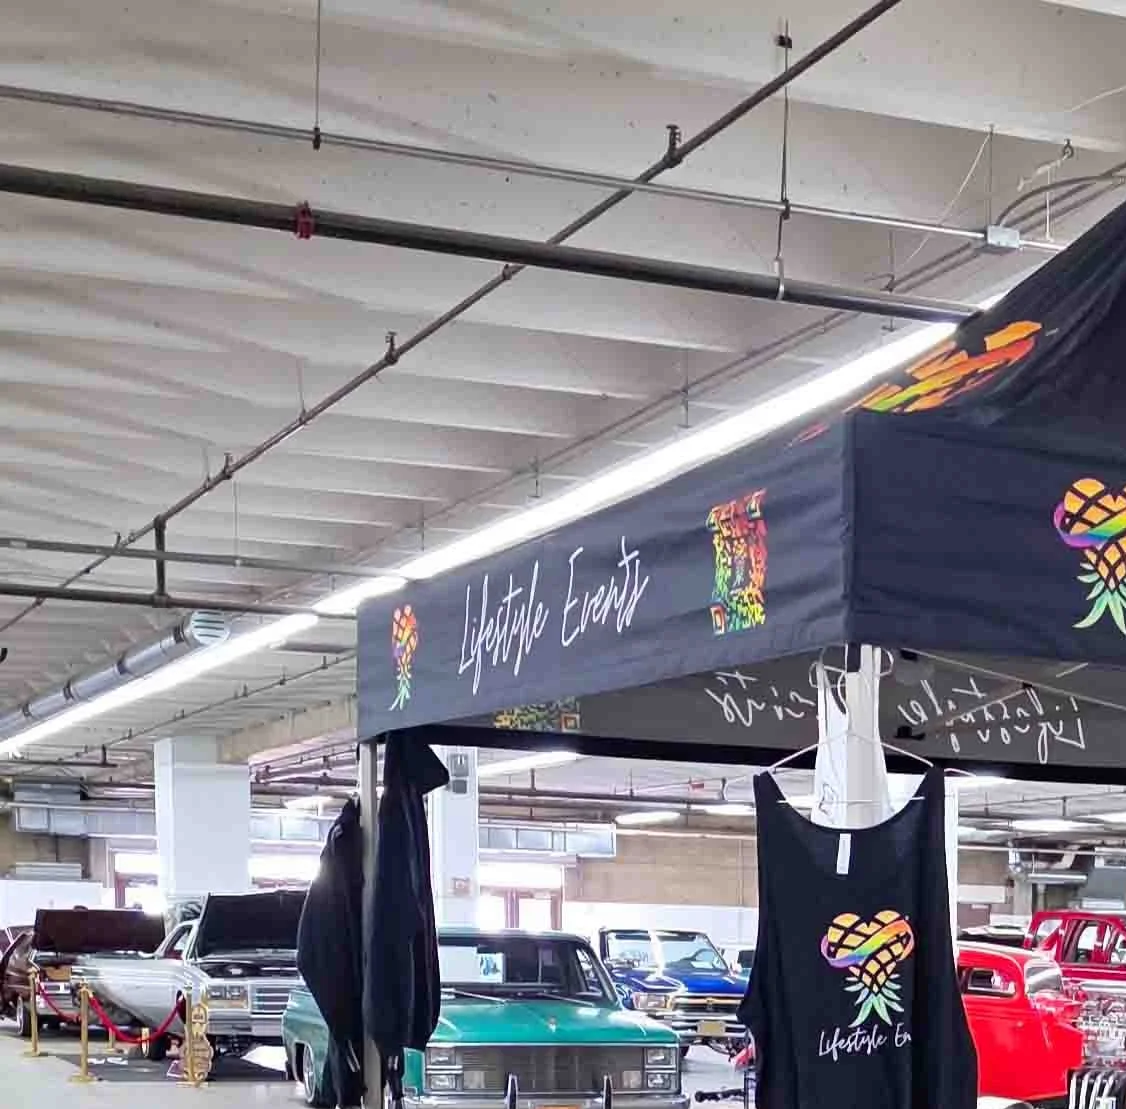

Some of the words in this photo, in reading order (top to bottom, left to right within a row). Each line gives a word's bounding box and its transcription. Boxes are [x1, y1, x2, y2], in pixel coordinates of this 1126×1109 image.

[458, 559, 550, 696] Lifestyle
[561, 535, 650, 647] Events
[817, 1023, 889, 1063] Lifestyle
